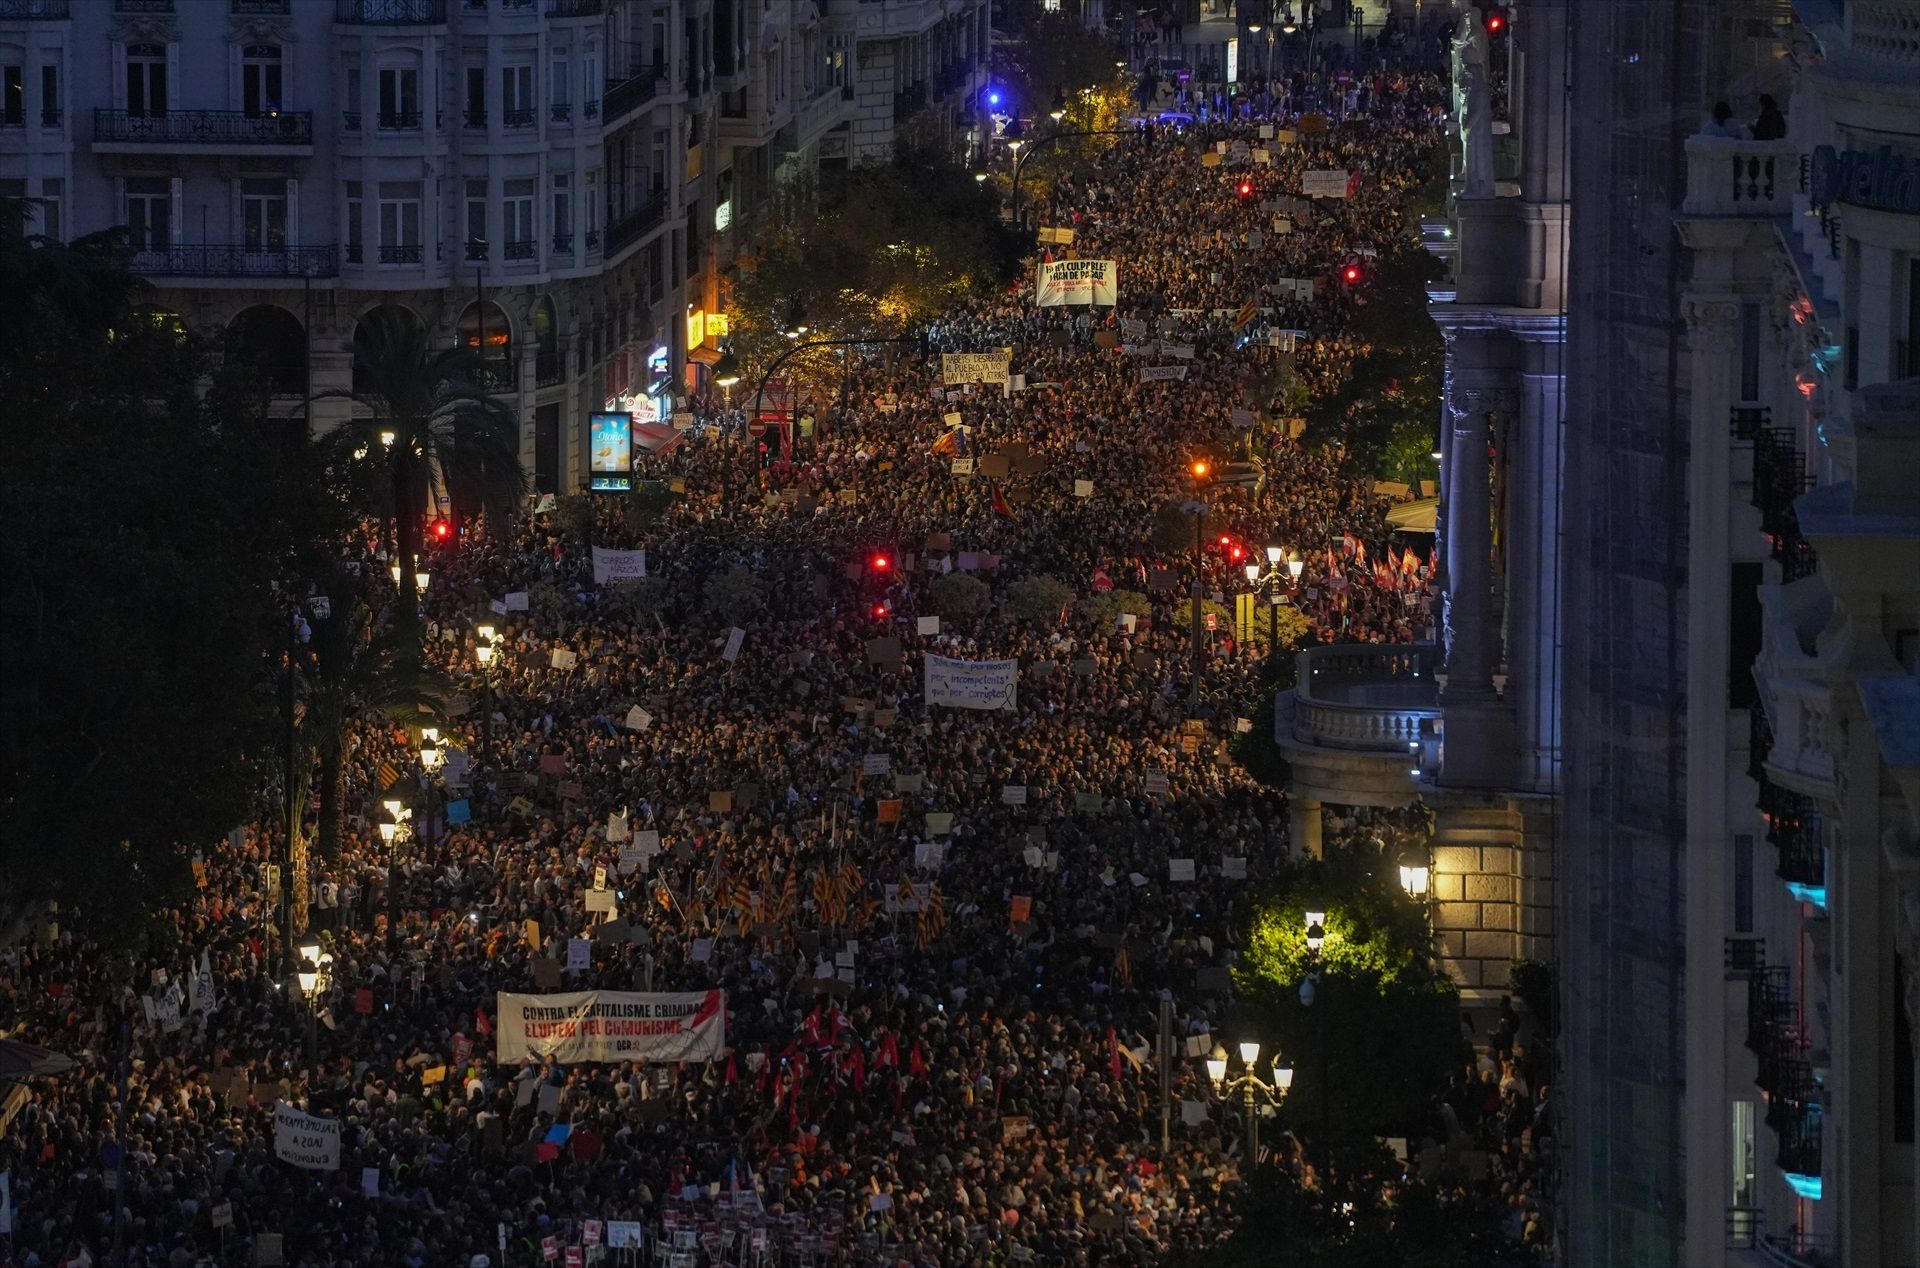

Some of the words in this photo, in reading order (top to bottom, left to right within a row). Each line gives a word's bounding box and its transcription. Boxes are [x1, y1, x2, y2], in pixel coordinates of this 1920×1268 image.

[1066, 261, 1108, 272] CULPABLES
[1069, 271, 1079, 280] DE
[523, 1006, 565, 1020] CONTRA
[568, 1005, 580, 1019] EL
[583, 1003, 651, 1018] CAPITALISME
[654, 1003, 706, 1018] CRIMINAL
[581, 1021, 601, 1036] PEL
[604, 1019, 683, 1036] COMUNISME
